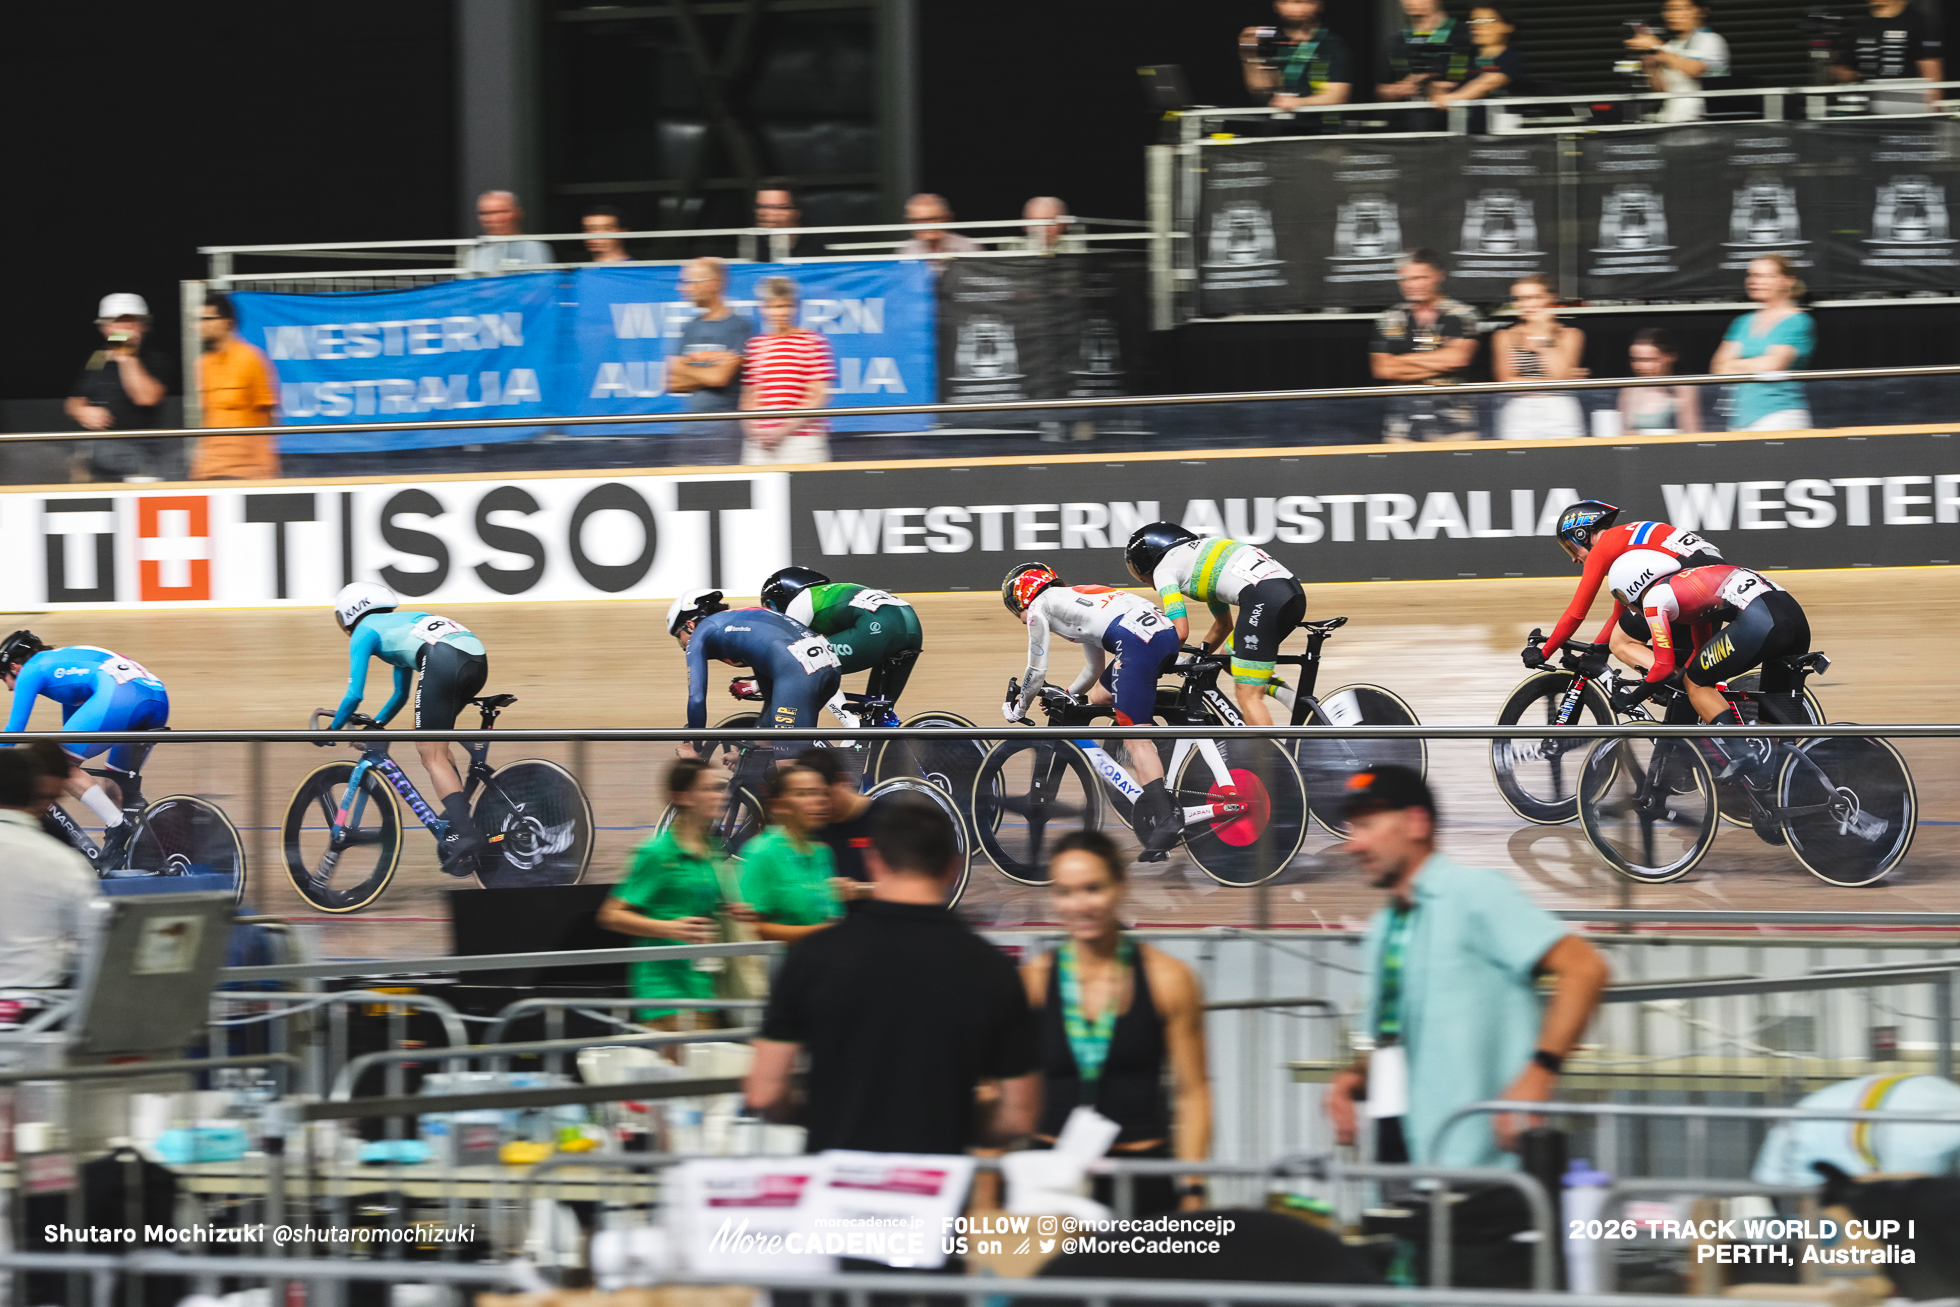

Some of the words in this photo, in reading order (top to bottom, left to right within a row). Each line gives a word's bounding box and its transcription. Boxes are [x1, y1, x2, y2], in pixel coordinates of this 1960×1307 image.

[263, 312, 524, 361] WESTERN
[271, 368, 542, 418] USTRALIA
[812, 500, 1160, 556] WESTERN
[243, 480, 753, 599] TISSOT
[1678, 532, 1700, 547] 13
[1250, 558, 1267, 572] 1
[1626, 568, 1655, 596] KASK
[1736, 578, 1757, 595] 3
[427, 620, 446, 632] 8
[1136, 610, 1158, 627] 10
[806, 646, 824, 657] 6
[1700, 634, 1736, 671] CHINA
